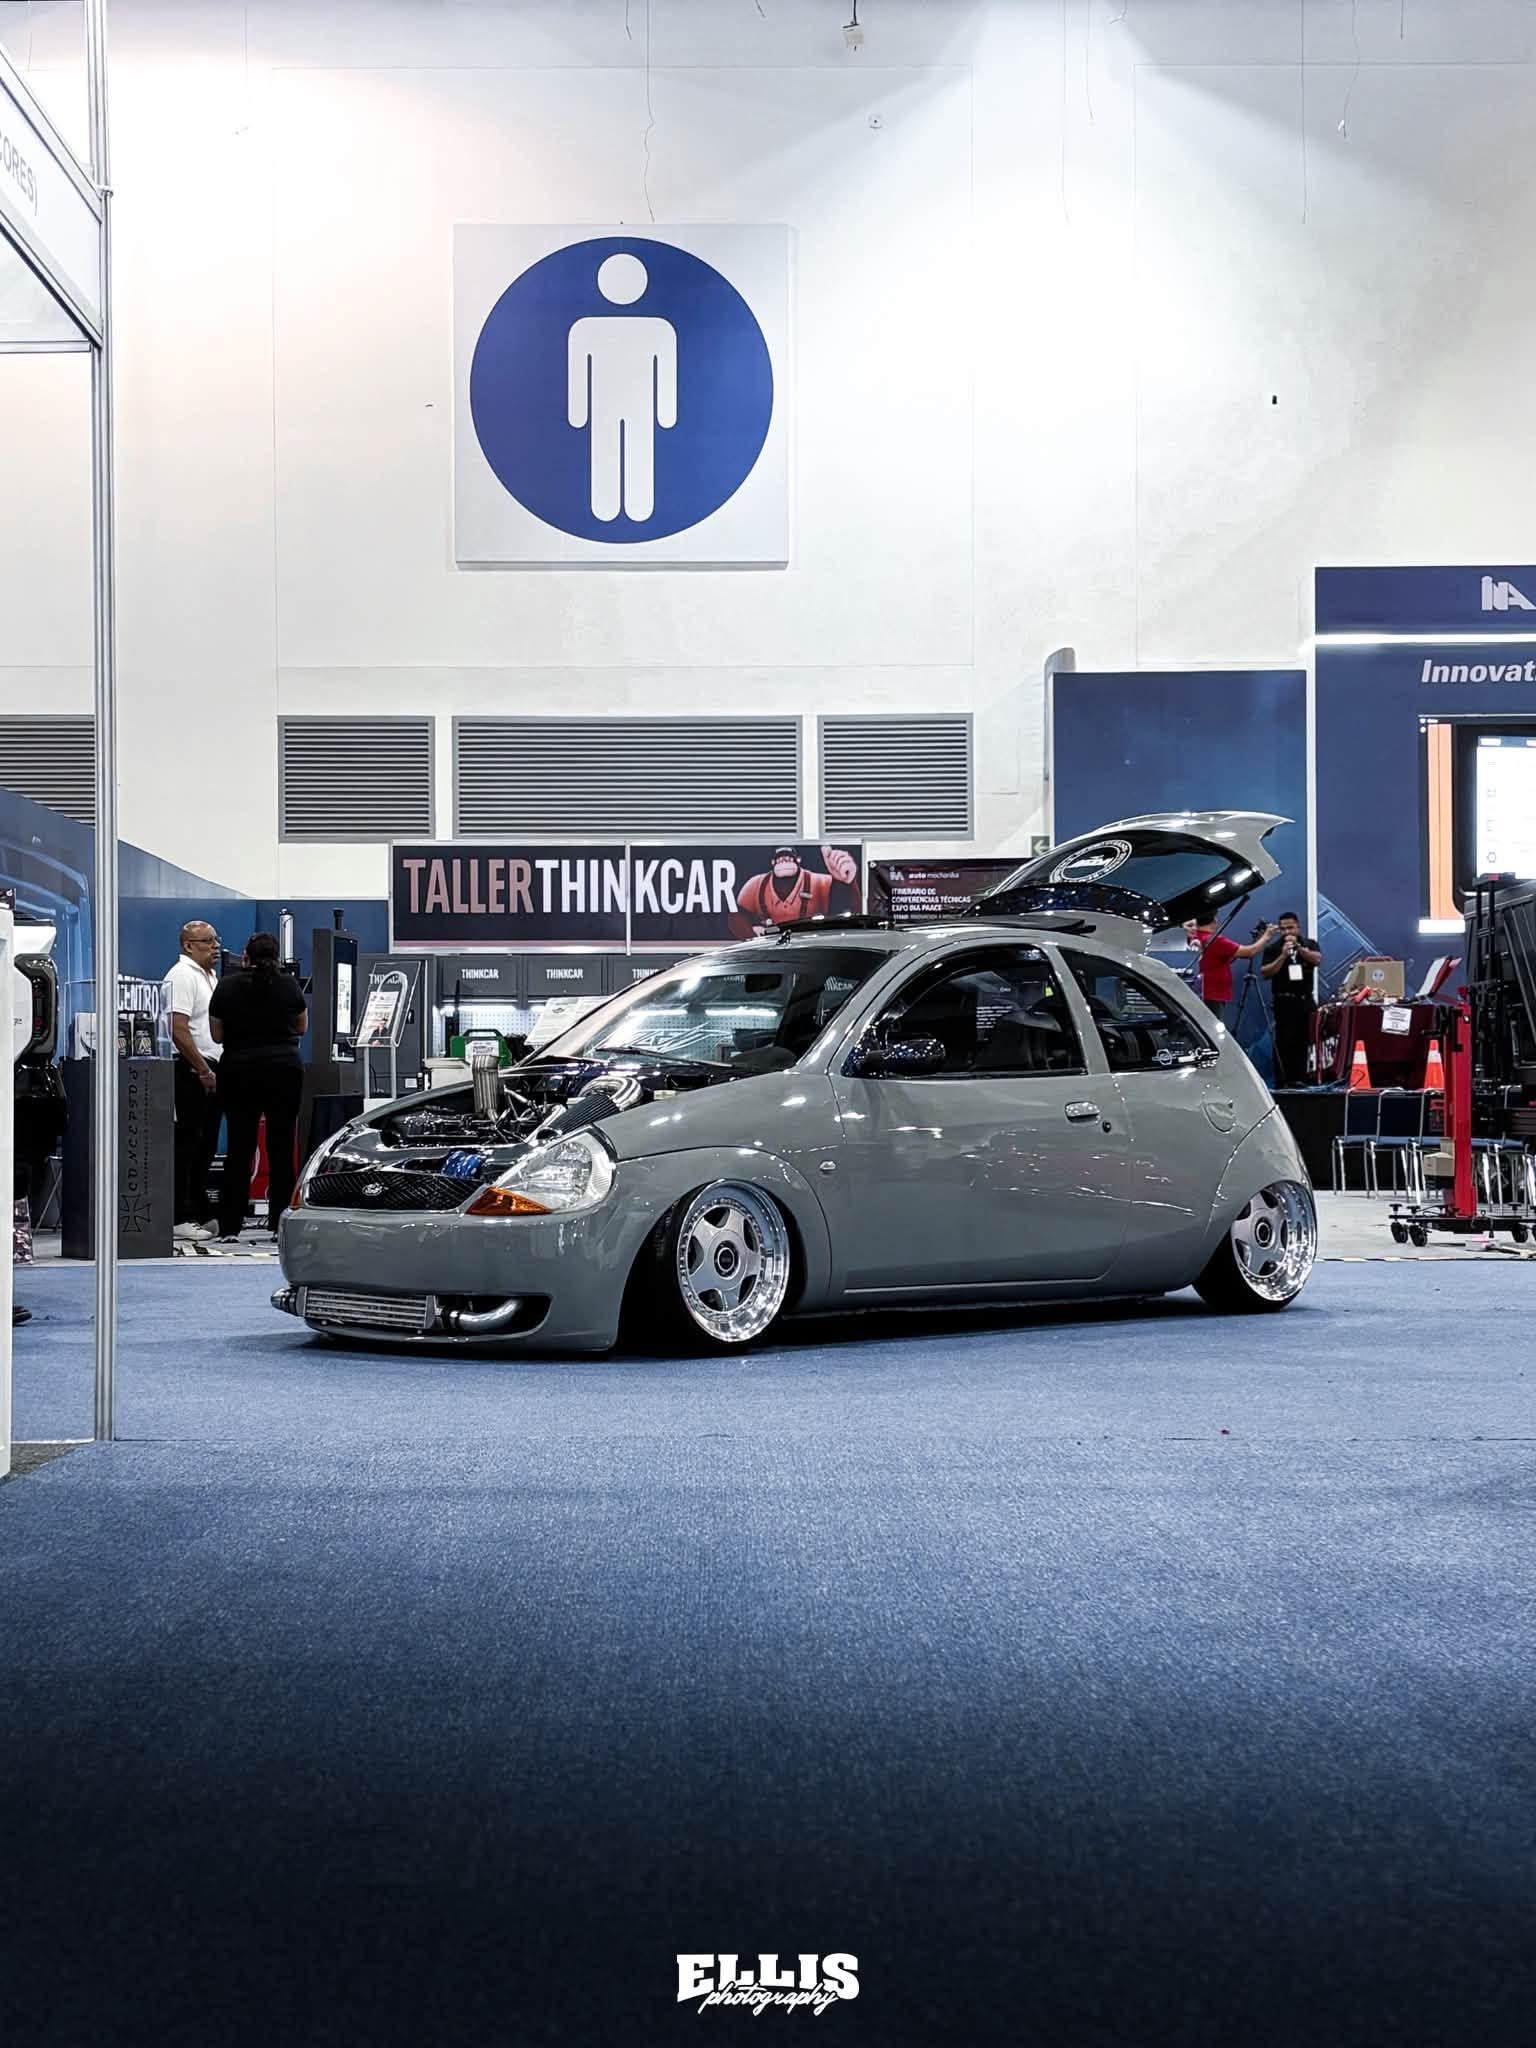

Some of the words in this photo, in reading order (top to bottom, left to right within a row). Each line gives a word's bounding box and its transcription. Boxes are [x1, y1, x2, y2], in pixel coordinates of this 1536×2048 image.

[0, 130, 38, 216] ORES)
[1422, 660, 1536, 682] Innovat
[927, 888, 937, 896] DE
[891, 896, 939, 904] CONFERENCIAS
[940, 895, 972, 904] TÉCNICAS
[461, 968, 499, 980] THINKCAR
[546, 968, 584, 980] THINKCAR
